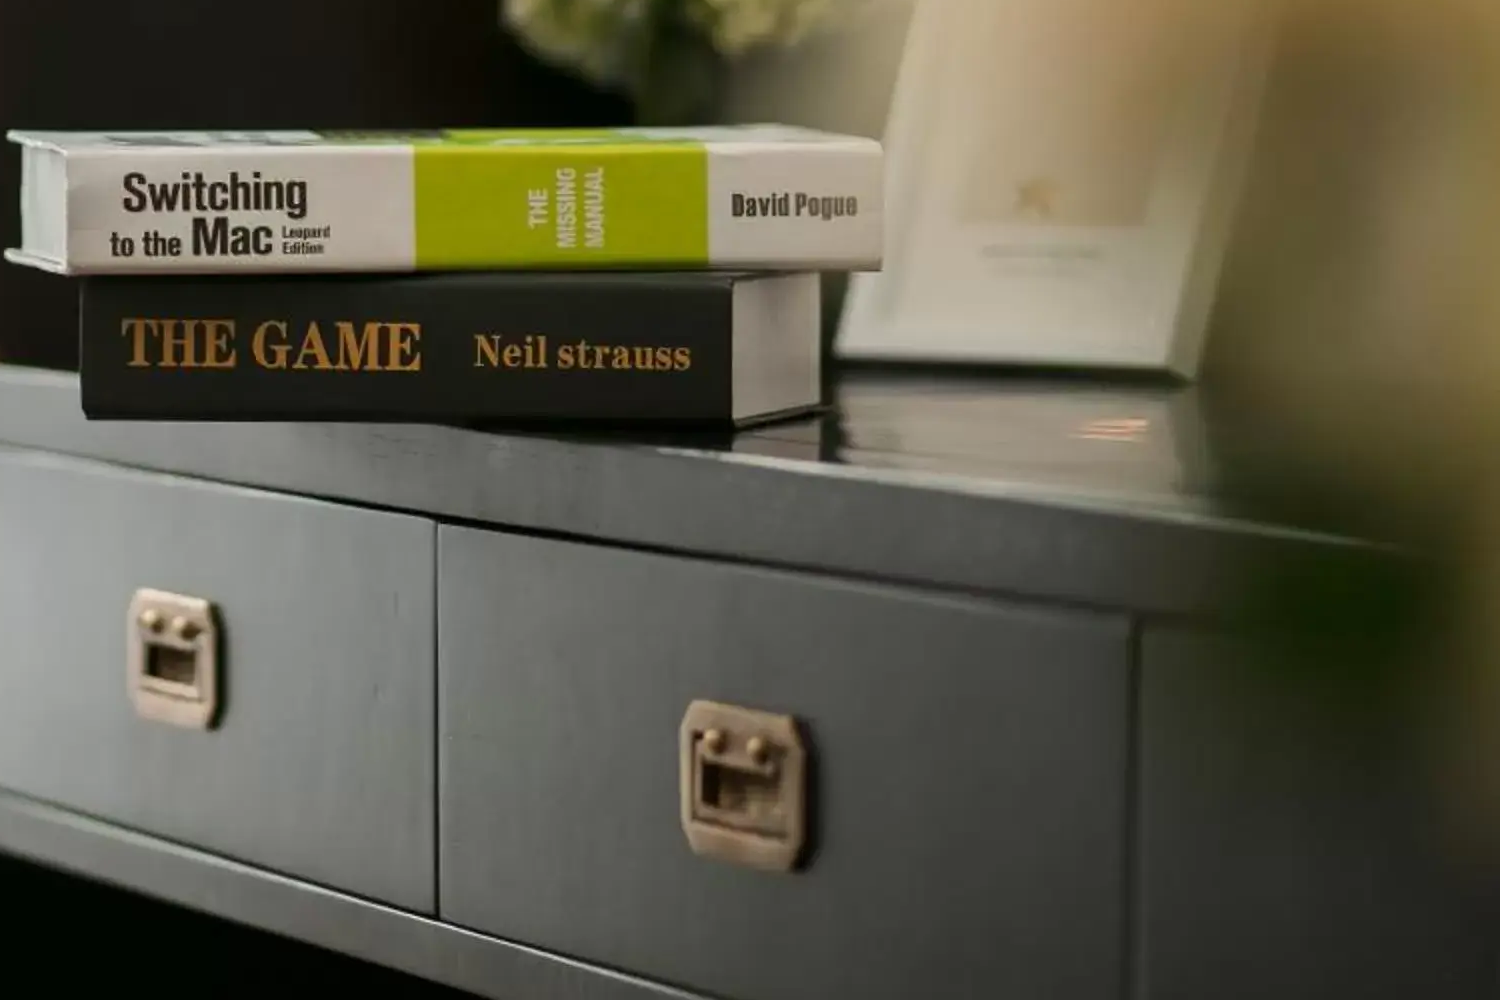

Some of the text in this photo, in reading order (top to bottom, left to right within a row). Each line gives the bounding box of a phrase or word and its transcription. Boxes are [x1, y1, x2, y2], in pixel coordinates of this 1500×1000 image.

[123, 172, 307, 218] Switching
[528, 188, 548, 228] THE
[556, 167, 576, 248] MISSING
[585, 167, 605, 248] MANUAL
[732, 193, 858, 221] David Pogue
[110, 218, 273, 257] to the Mac
[282, 224, 331, 241] Leopard
[282, 241, 325, 255] Edition
[121, 317, 421, 372] THE GAME
[473, 334, 692, 371] Neil strauss
